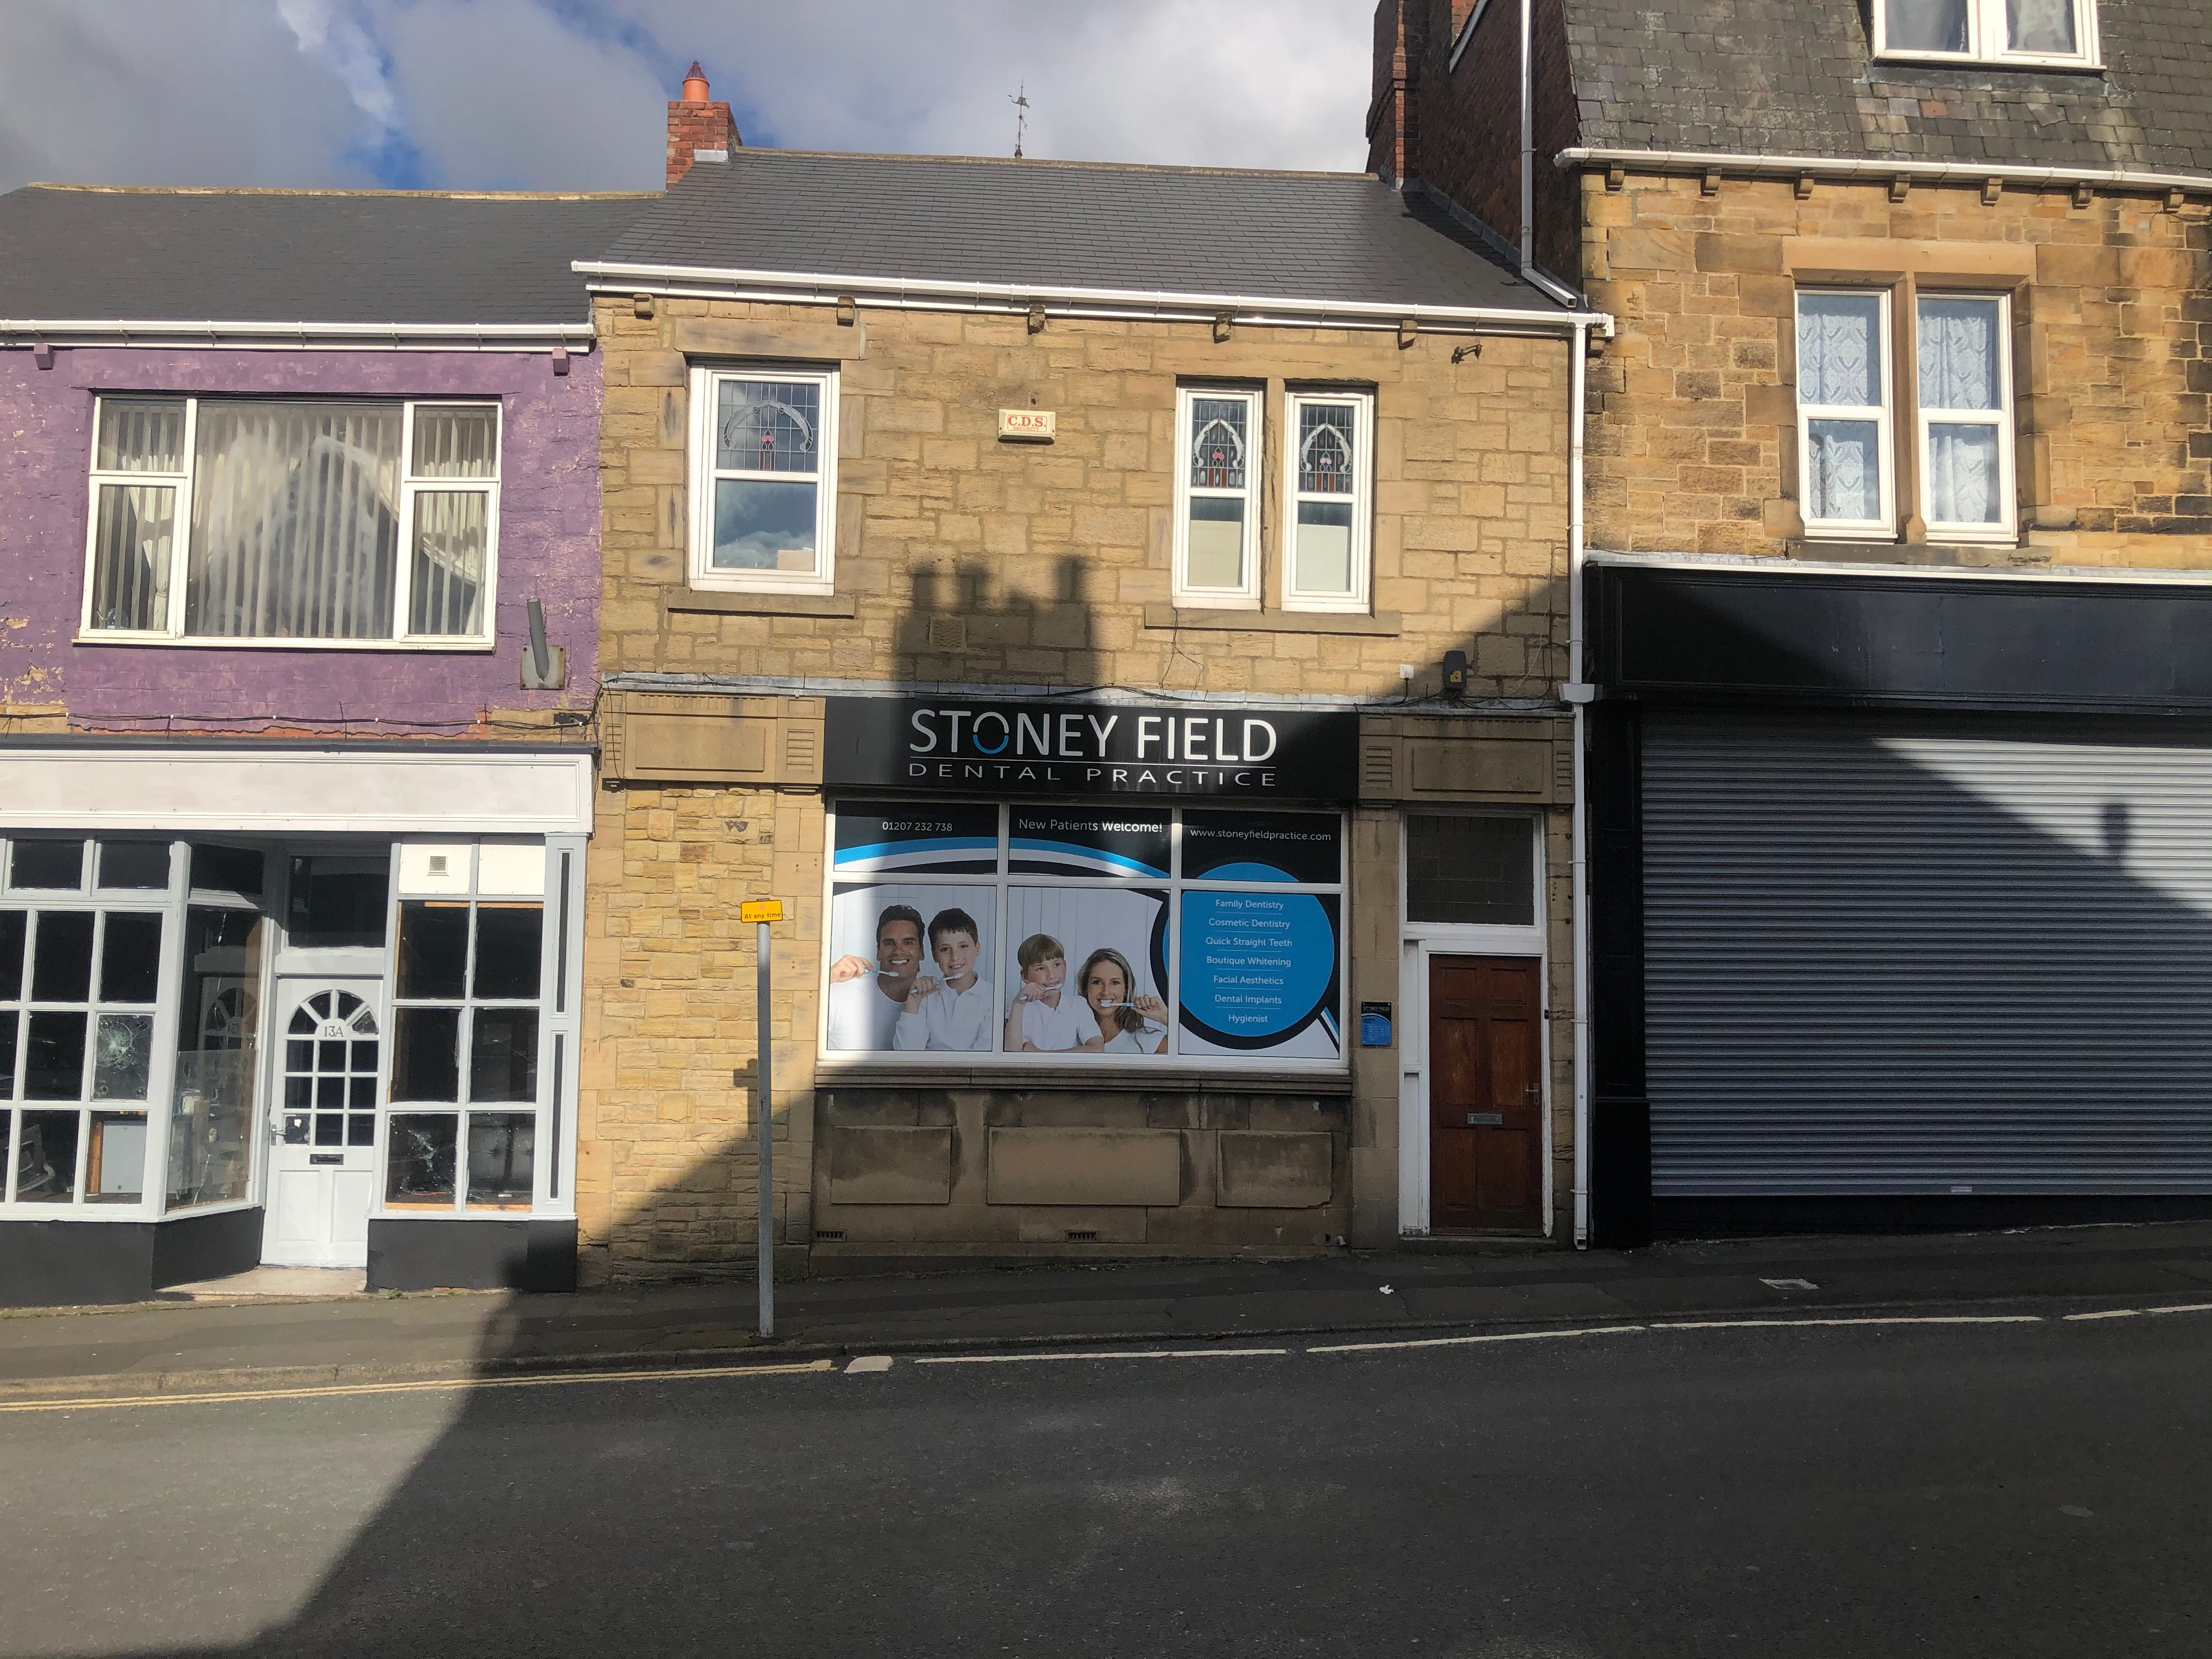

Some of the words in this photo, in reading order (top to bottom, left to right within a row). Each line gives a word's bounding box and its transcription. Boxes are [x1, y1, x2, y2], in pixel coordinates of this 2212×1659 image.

[1008, 416, 1046, 427] C.D.S.
[910, 709, 1118, 757] STONEY
[1138, 716, 1276, 761] FIELD
[910, 764, 1060, 780] DENTAL
[1087, 767, 1276, 786] PRACTICE
[883, 822, 912, 830] 01207
[915, 822, 932, 831] 232
[935, 823, 952, 831] 738
[1019, 819, 1046, 829] New
[1051, 820, 1098, 831] Patients
[1102, 821, 1163, 832] Welcome!
[1190, 829, 1331, 840] www.stoneyfieldpractice.com
[1216, 900, 1243, 909] Family
[1246, 900, 1283, 910] Dentistry
[1252, 919, 1290, 929] Dentistry
[1234, 938, 1266, 947] Straight
[1207, 956, 1245, 966] Boutique
[1248, 957, 1291, 967] Whitening
[1246, 996, 1282, 1005] Implants
[1229, 1014, 1268, 1023] Hygienist
[324, 1025, 344, 1037] 13A
